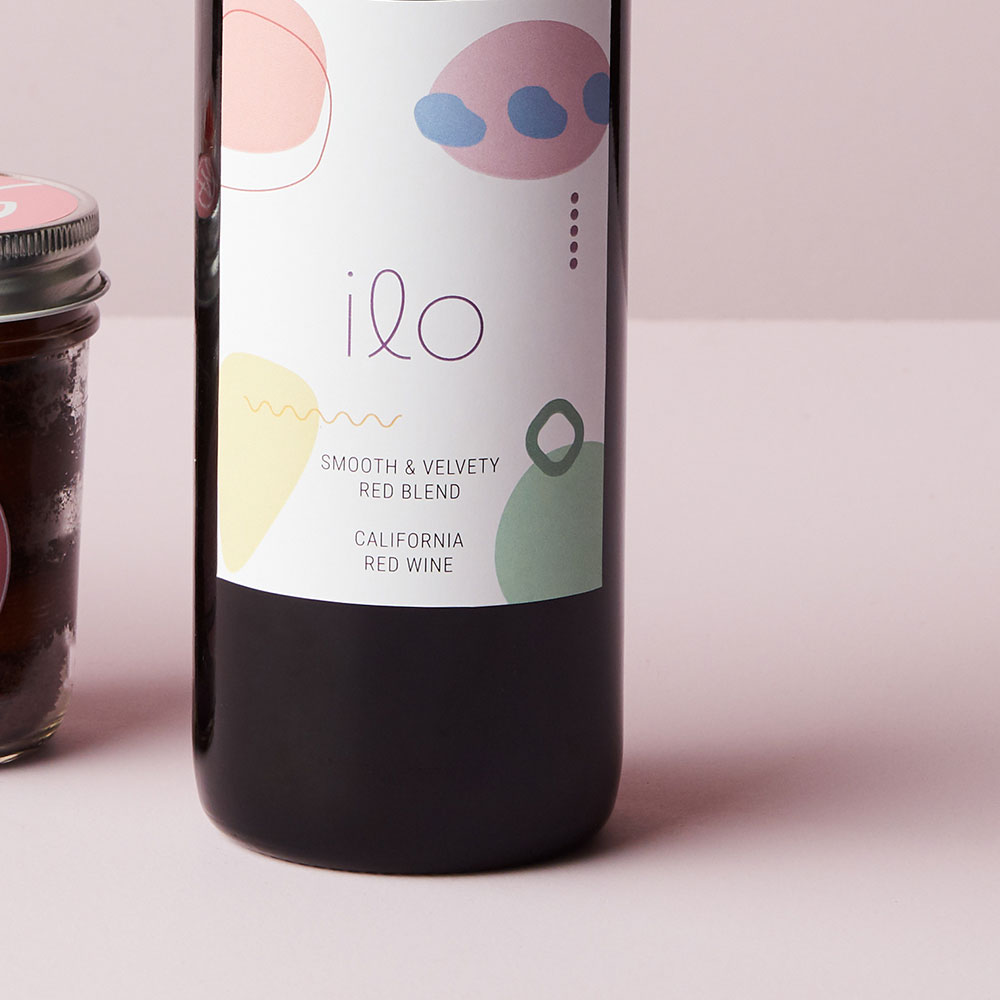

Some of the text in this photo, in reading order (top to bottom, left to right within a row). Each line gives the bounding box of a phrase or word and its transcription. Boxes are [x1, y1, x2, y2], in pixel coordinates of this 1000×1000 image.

[346, 268, 484, 362] ilo
[320, 454, 500, 475] SMOOTH & VELVETY
[359, 482, 461, 500] RED BLEND
[354, 530, 464, 549] CALIFORNIA
[364, 556, 454, 573] RED WINE
